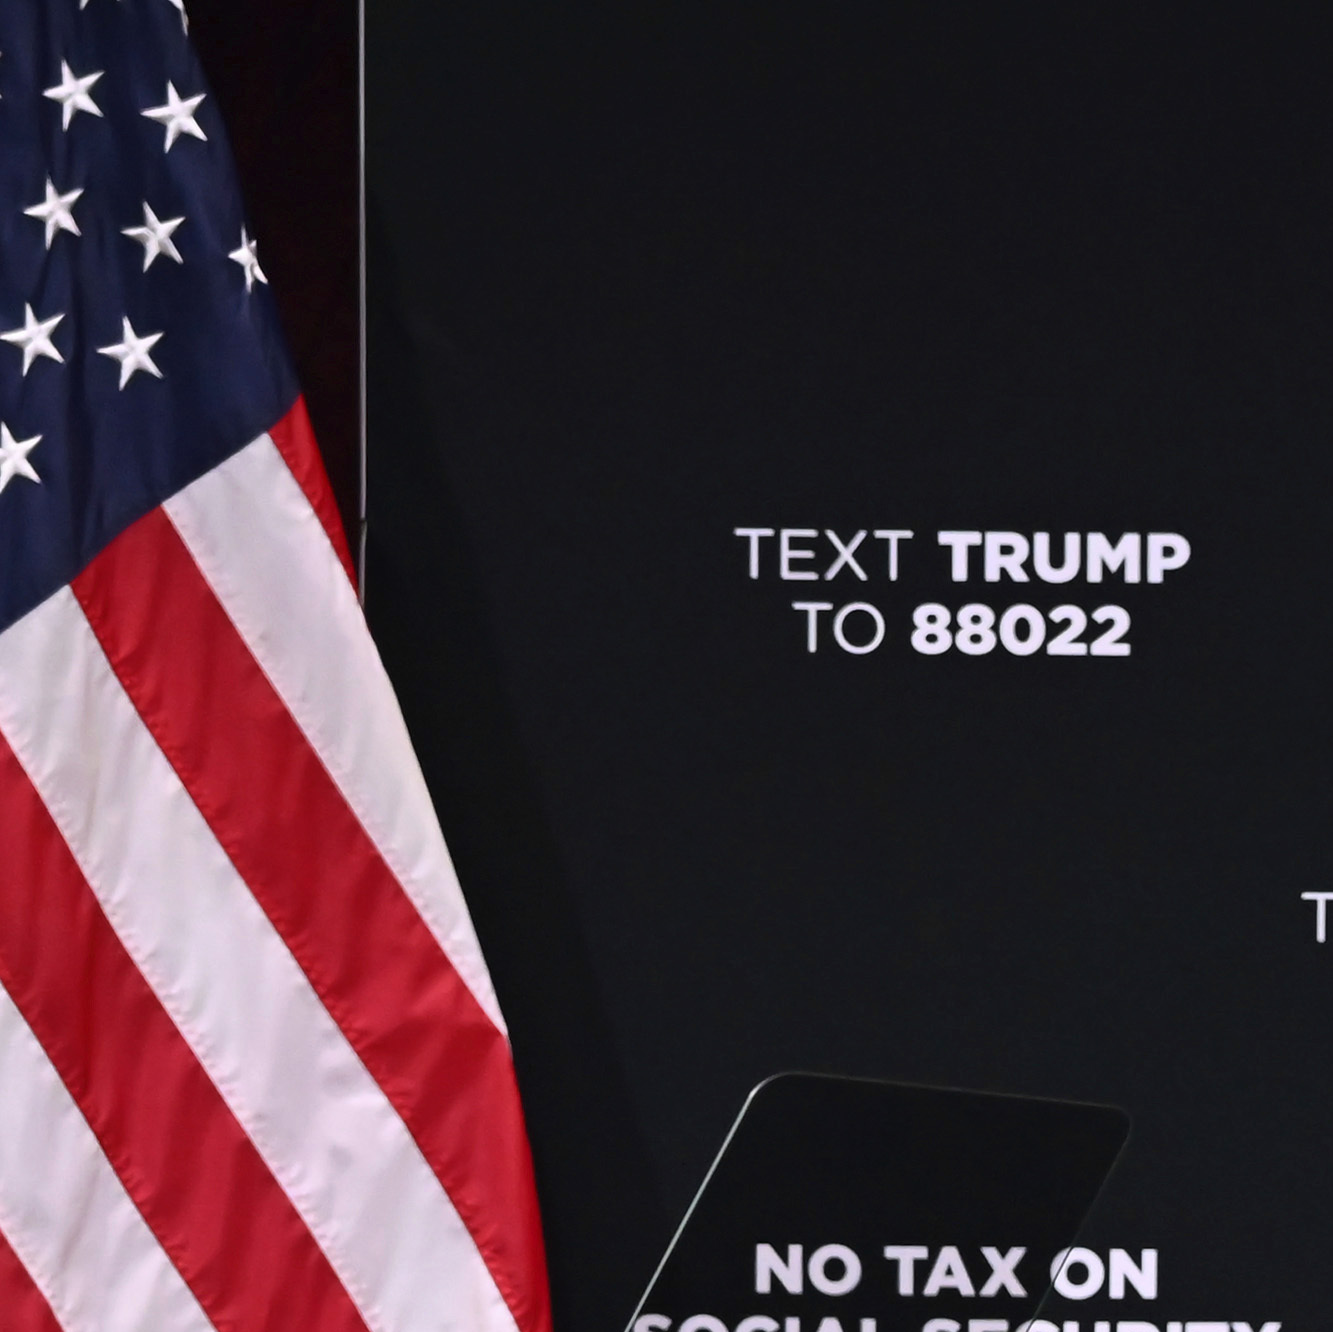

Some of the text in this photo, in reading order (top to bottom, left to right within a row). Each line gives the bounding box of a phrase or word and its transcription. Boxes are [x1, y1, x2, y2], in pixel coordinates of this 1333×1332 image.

[735, 528, 1190, 583] TEXT TRUMP
[792, 602, 1130, 656] TO 88022
[755, 1243, 1158, 1300] NO TAX ON
